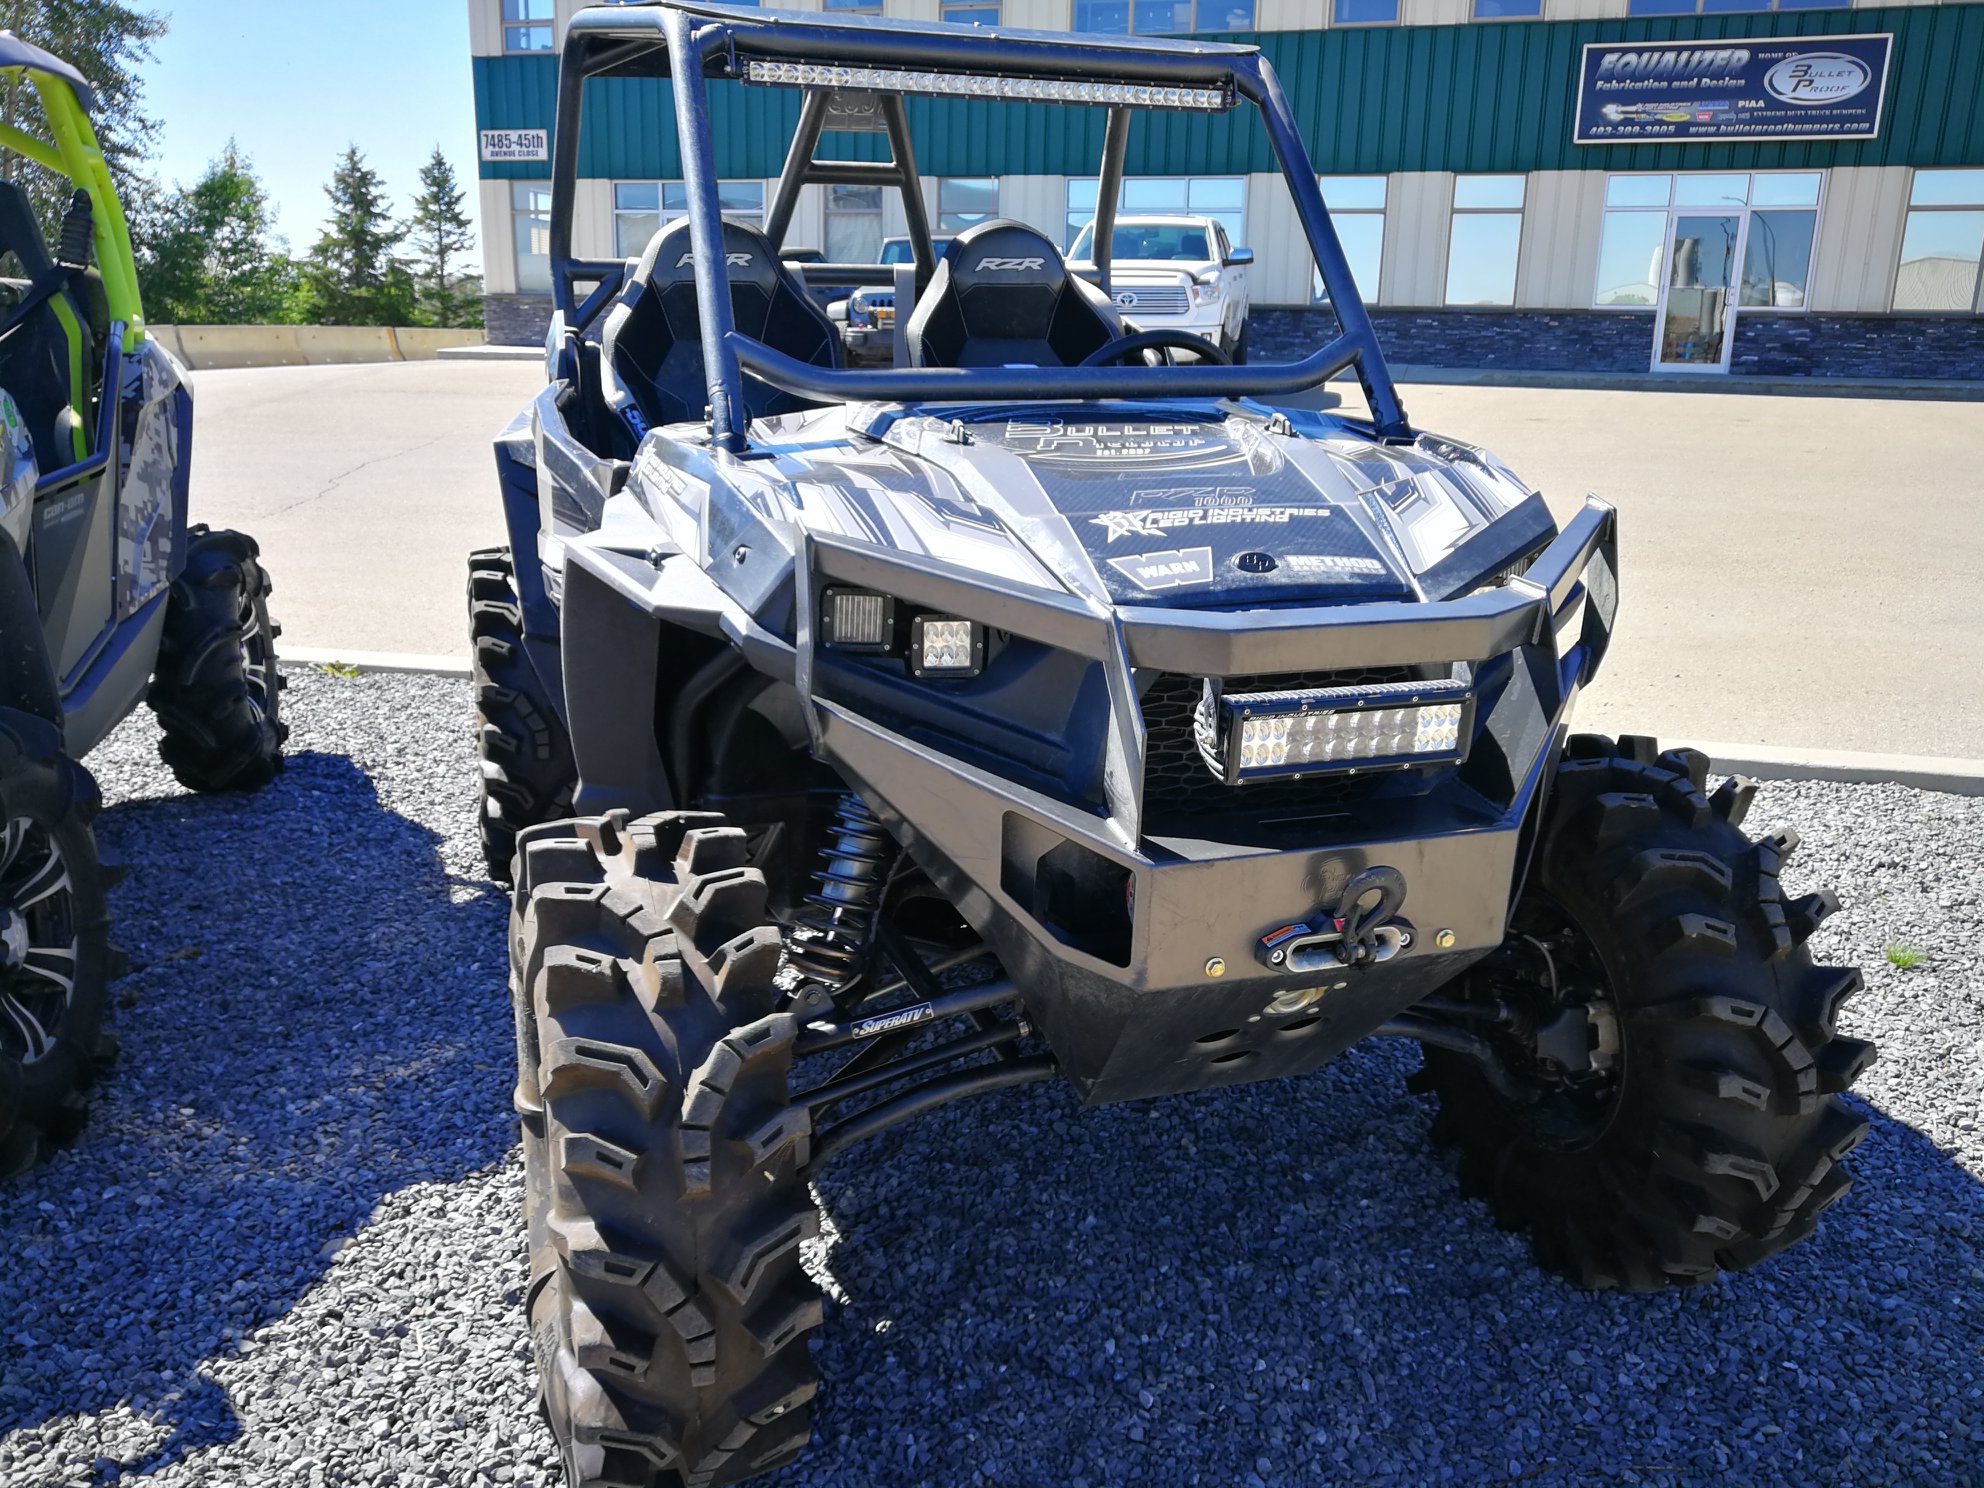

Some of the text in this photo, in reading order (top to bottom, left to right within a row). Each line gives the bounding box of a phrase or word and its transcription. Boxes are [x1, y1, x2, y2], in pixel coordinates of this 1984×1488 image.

[1595, 49, 1750, 78] EQUALIZER
[1789, 64, 1855, 78] BULLET
[1595, 77, 1746, 91] Fabrication and Design
[1791, 79, 1850, 93] PROOF
[1737, 99, 1765, 108] PIAA
[1689, 122, 1870, 135] www.bulletproofbumpers.com
[483, 133, 544, 149] 7485-45th
[675, 253, 753, 268] RR
[975, 257, 1045, 272] RZR
[1149, 508, 1331, 519] RIGID INDUSTRIES
[1146, 514, 1290, 529] LED LIGHTING
[1286, 555, 1383, 568] METHOD
[1136, 560, 1201, 579] WARN
[1277, 709, 1336, 719] INDUSTRIES
[859, 1007, 924, 1035] SUPERATV
